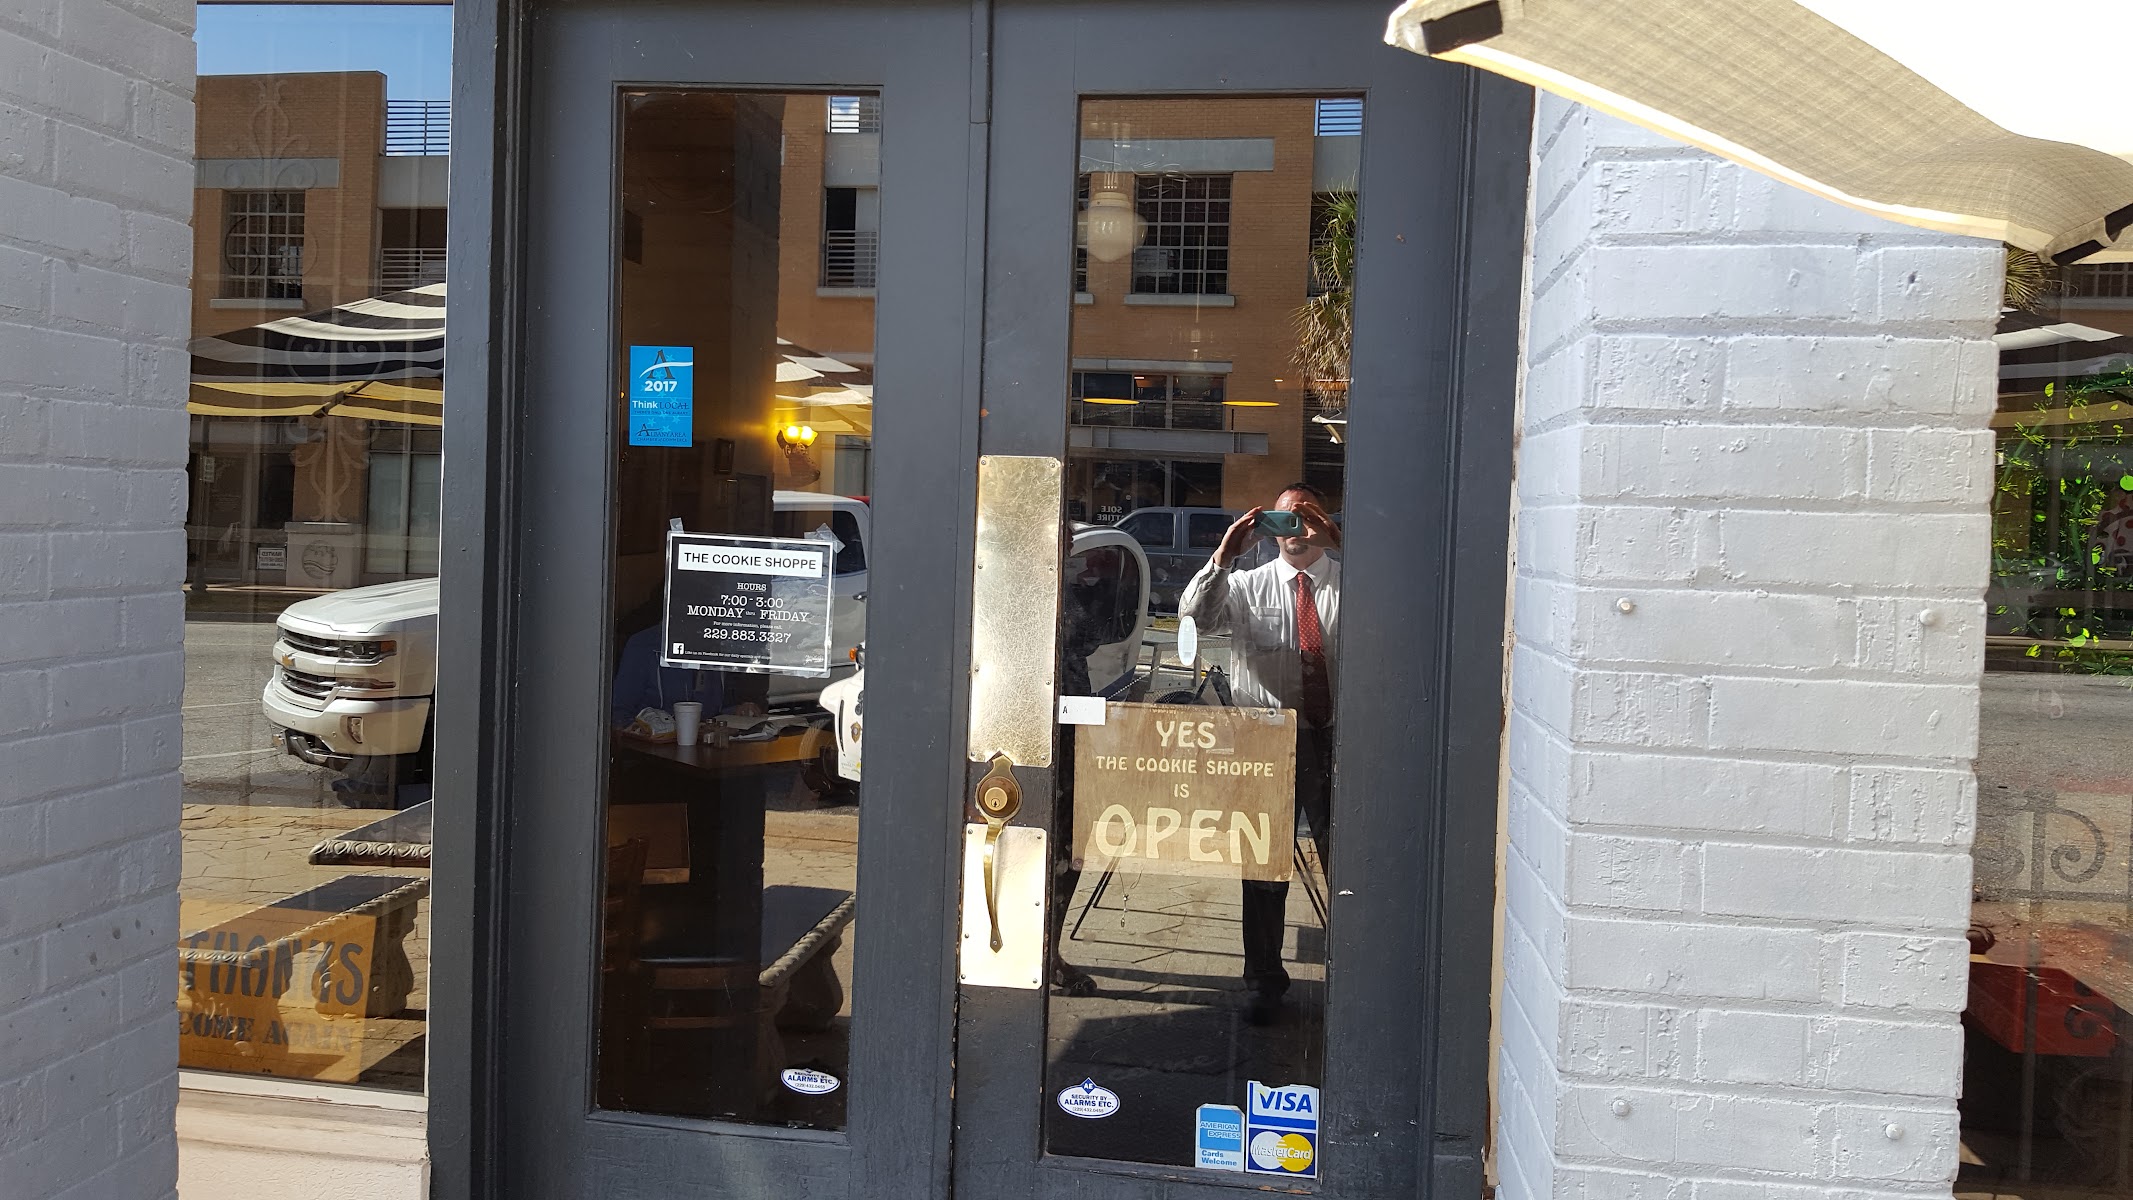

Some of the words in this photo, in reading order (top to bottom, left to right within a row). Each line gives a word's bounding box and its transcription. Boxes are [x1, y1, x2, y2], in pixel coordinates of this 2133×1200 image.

[644, 380, 678, 392] 2017
[632, 400, 658, 409] Think
[684, 552, 709, 563] THE
[712, 554, 762, 567] COOKIE
[765, 557, 817, 570] SHOPPE
[737, 582, 767, 591] HOURS
[721, 595, 748, 607] 7:00
[756, 597, 783, 609] 3:00
[687, 605, 745, 619] MONDAY
[759, 610, 810, 622] FRIDAY
[704, 628, 792, 643] 229.883.3327
[1156, 720, 1217, 749] YES
[1096, 755, 1128, 770] THE
[1135, 757, 1198, 774] COOKIE
[1206, 760, 1274, 778] SHOPPE
[1174, 784, 1190, 798] IS
[1095, 804, 1271, 864] OPEN
[184, 932, 364, 1006] THANKS
[788, 1075, 818, 1083] ALARMS
[1064, 1099, 1096, 1107] ALARMS
[1260, 1090, 1312, 1113] VISA
[1200, 1122, 1238, 1131] AMERICAN
[1208, 1131, 1241, 1139] EXPRESS
[1202, 1150, 1224, 1158] Cards
[1252, 1145, 1312, 1160] MasterCard
[1202, 1157, 1237, 1166] Welcome
